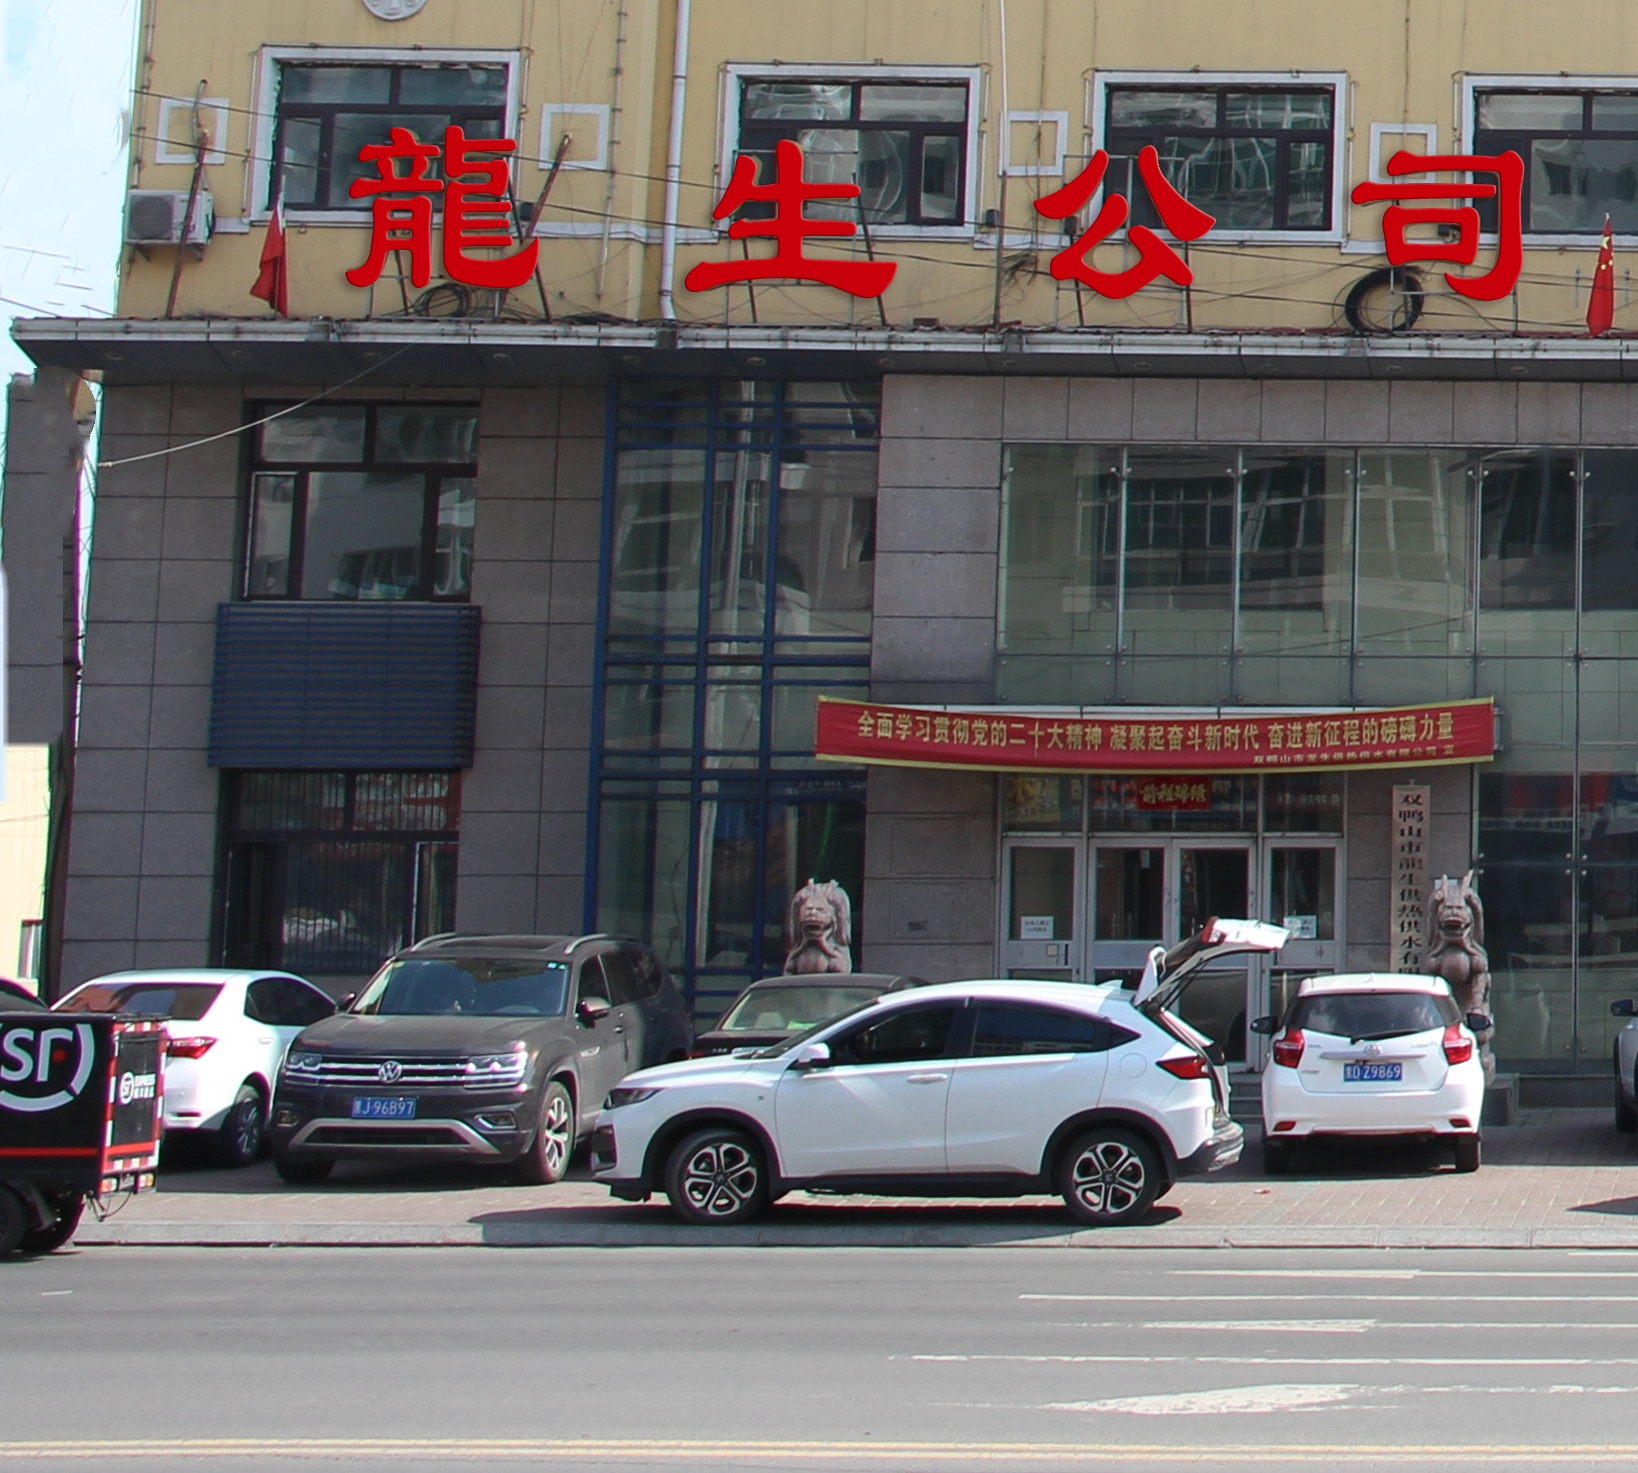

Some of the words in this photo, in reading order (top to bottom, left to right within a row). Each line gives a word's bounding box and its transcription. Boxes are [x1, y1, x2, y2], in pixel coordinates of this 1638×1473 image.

[345, 125, 1525, 302] 龍生公司
[857, 709, 1103, 752] 全面学习贯彻党的二十大精神
[1109, 722, 1260, 752] 凝聚起奋斗新时代
[1267, 712, 1454, 750] 奋进新征程的磅礴力量
